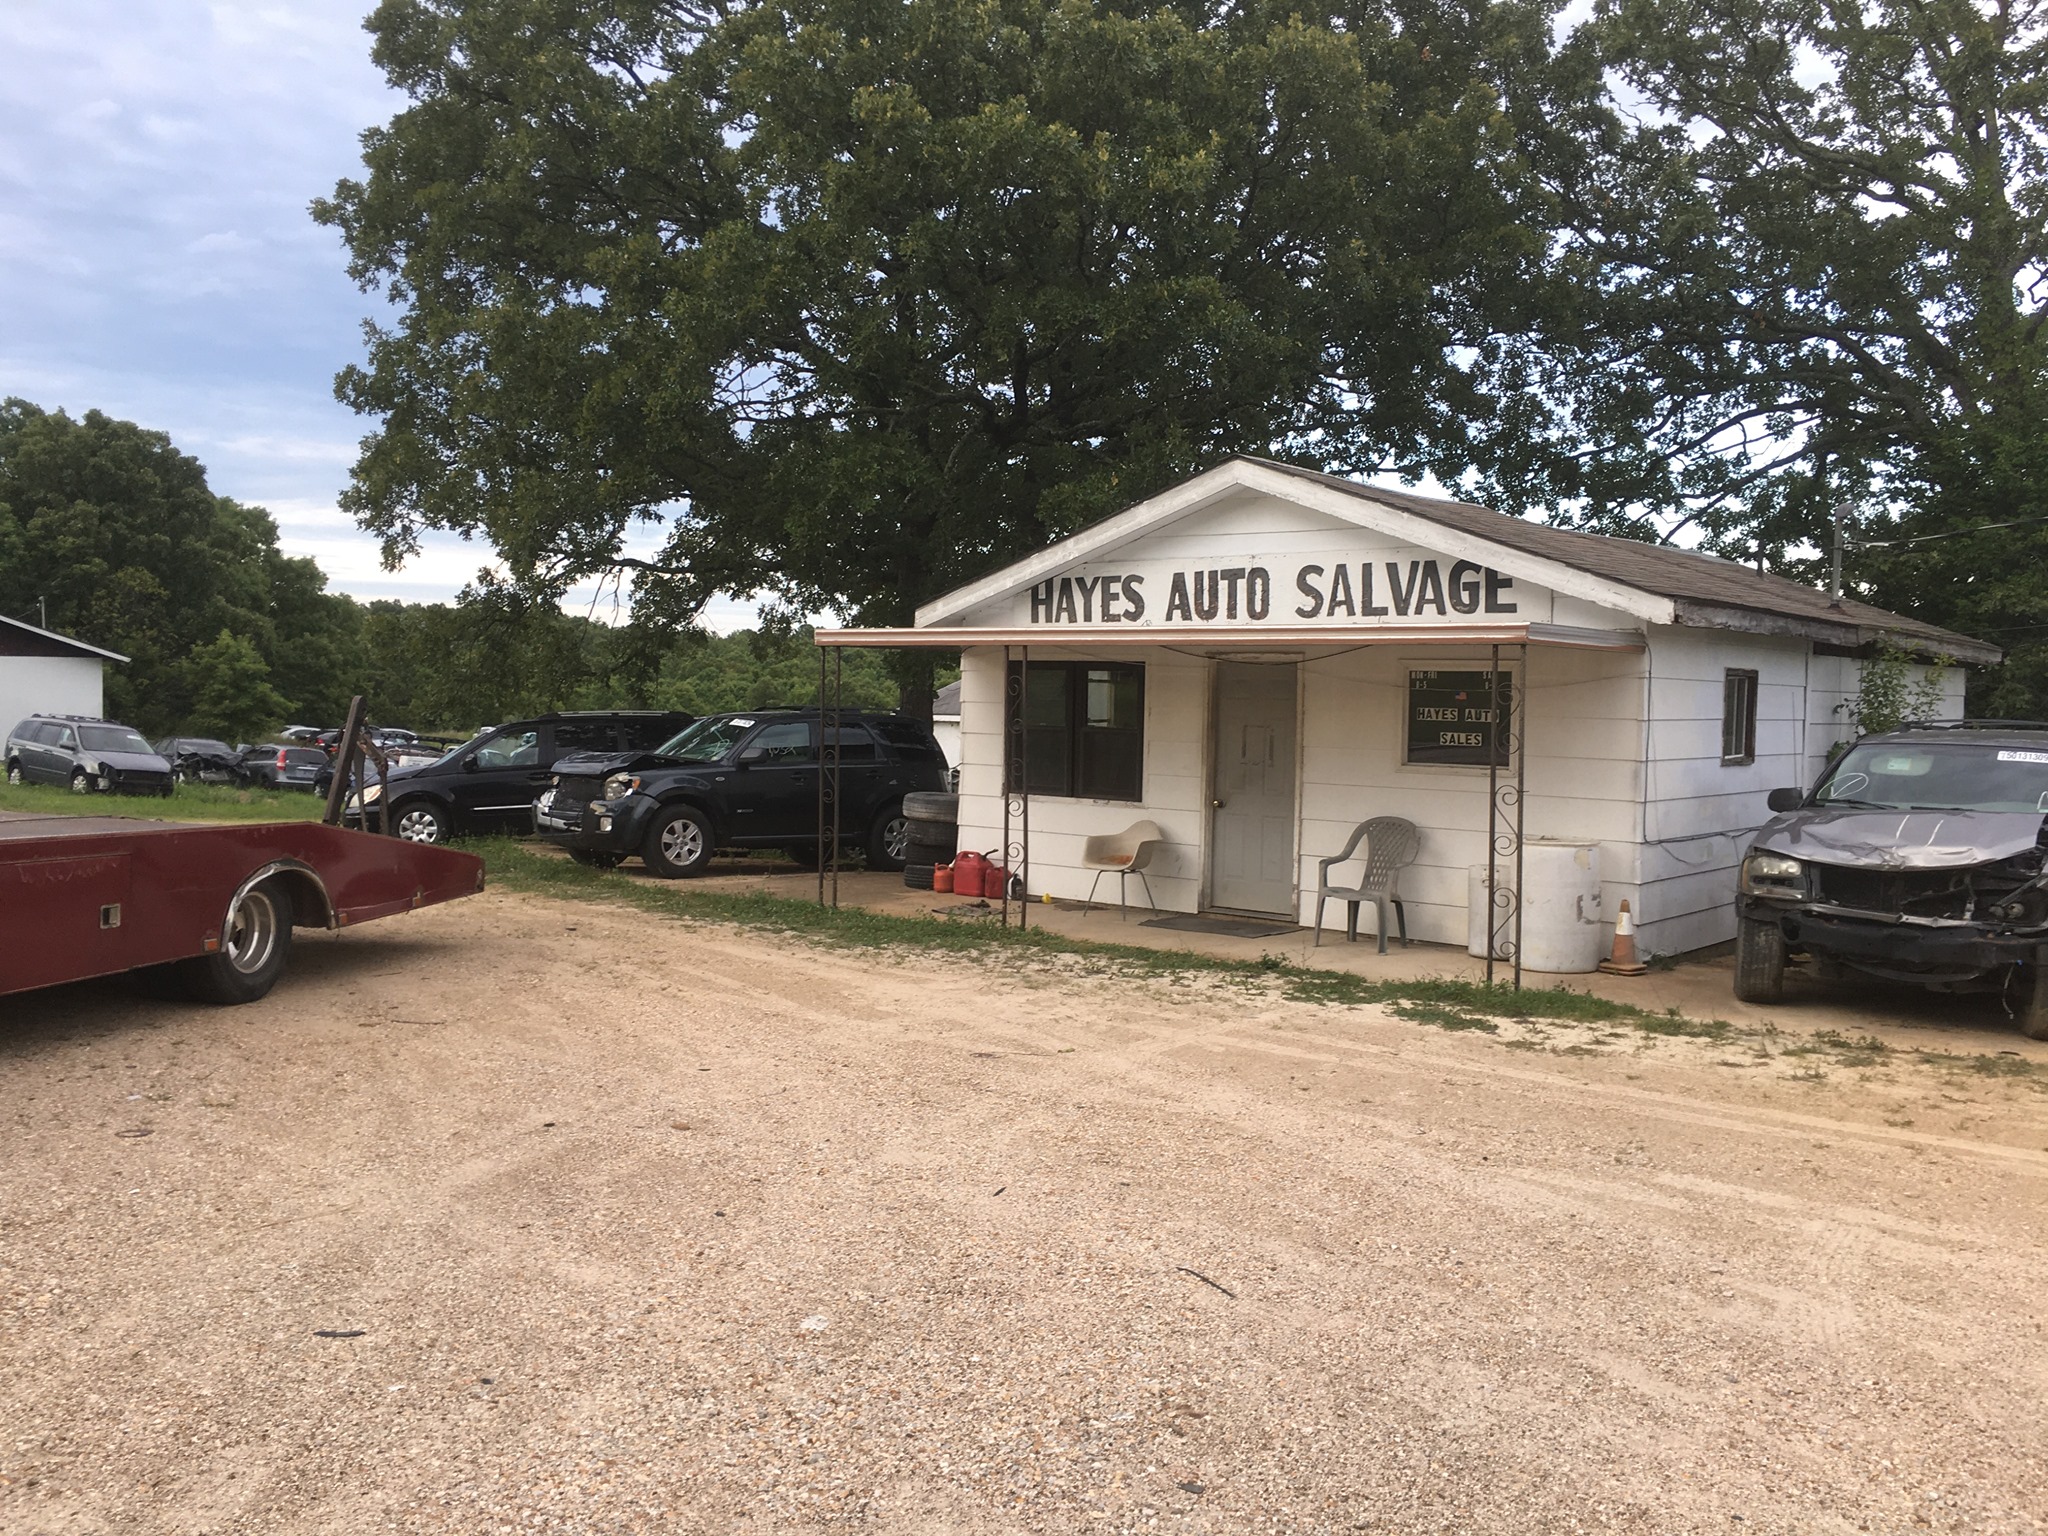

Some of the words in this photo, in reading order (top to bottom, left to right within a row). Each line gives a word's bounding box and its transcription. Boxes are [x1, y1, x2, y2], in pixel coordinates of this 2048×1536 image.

[1031, 574, 1145, 623] HAYES
[1165, 567, 1270, 621] AUTO
[1295, 560, 1518, 619] SALVAGE
[1417, 708, 1457, 720] HAYES
[1441, 733, 1481, 746] SALES
